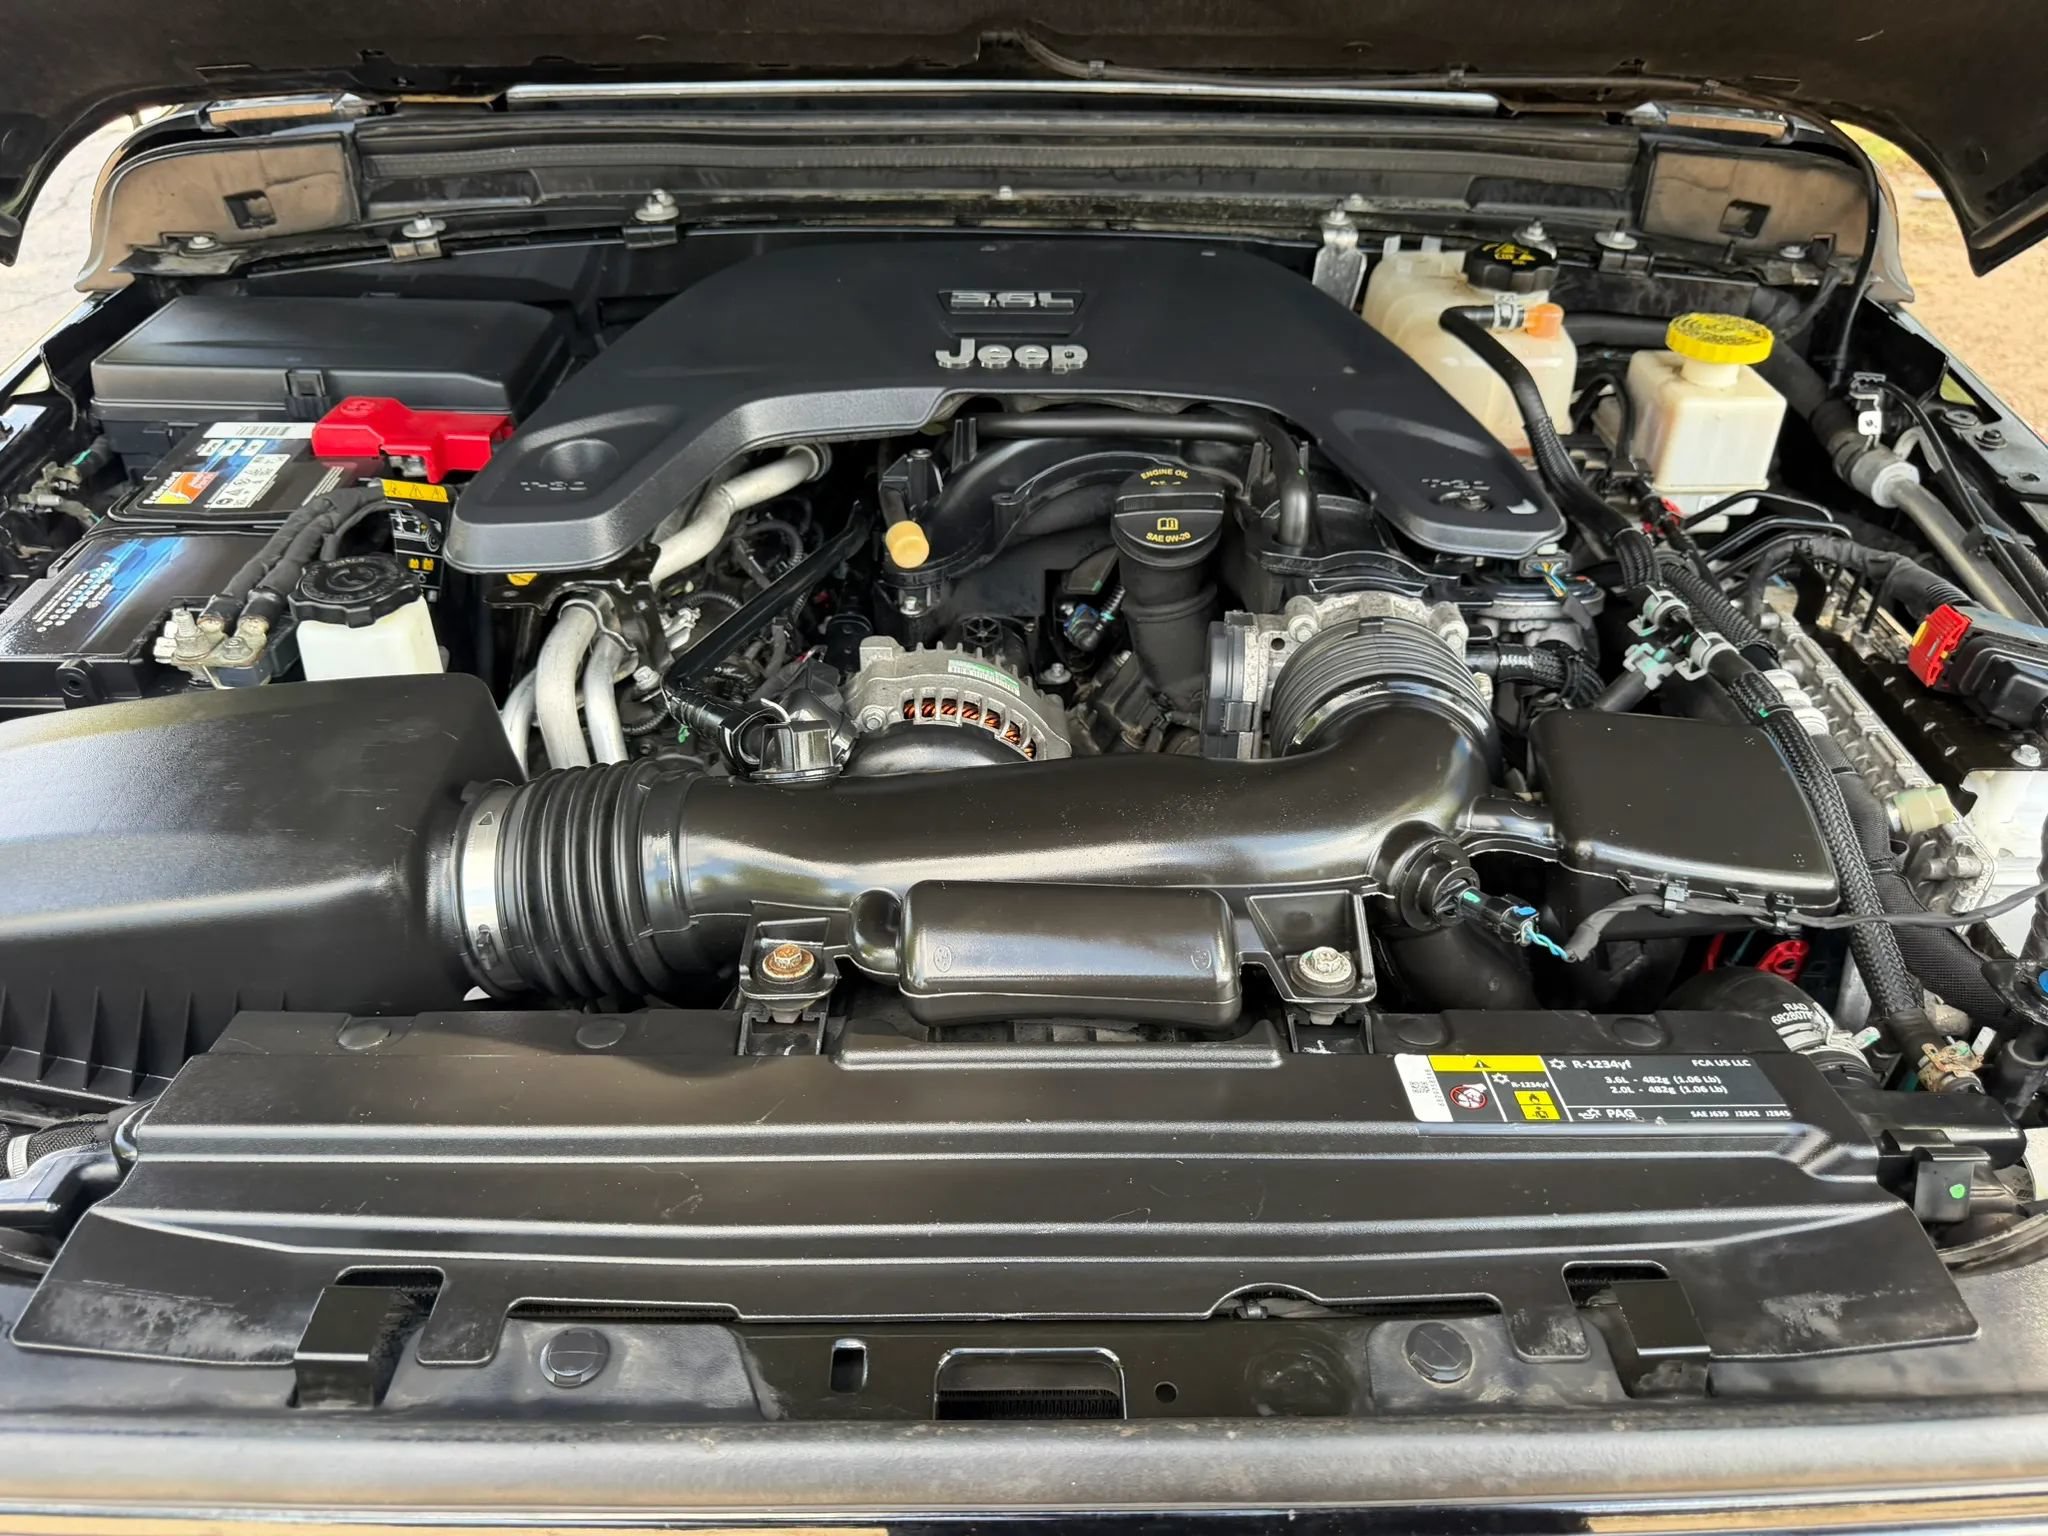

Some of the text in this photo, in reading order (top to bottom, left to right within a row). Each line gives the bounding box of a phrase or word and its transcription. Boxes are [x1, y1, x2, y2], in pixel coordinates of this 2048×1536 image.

[951, 291, 1074, 308] 3.6L
[935, 338, 1088, 374] Jeep
[1140, 468, 1189, 480] ENGINE OIL
[1146, 532, 1191, 542] SAE 0W-20
[1782, 1003, 1809, 1011] RAD
[1572, 1059, 1631, 1070] R-1234yf
[1691, 1059, 1752, 1067] FCA US LLC
[1511, 1081, 1549, 1089] R-1234yf
[1604, 1076, 1630, 1084] 3.6L
[1642, 1076, 1670, 1085] 482g
[1673, 1075, 1702, 1084] (1.06
[1610, 1086, 1635, 1094] 2.0L
[1648, 1086, 1677, 1095] 482g
[1679, 1085, 1708, 1094] (1.06
[1606, 1109, 1637, 1118] PAG
[1690, 1110, 1709, 1118] SAE
